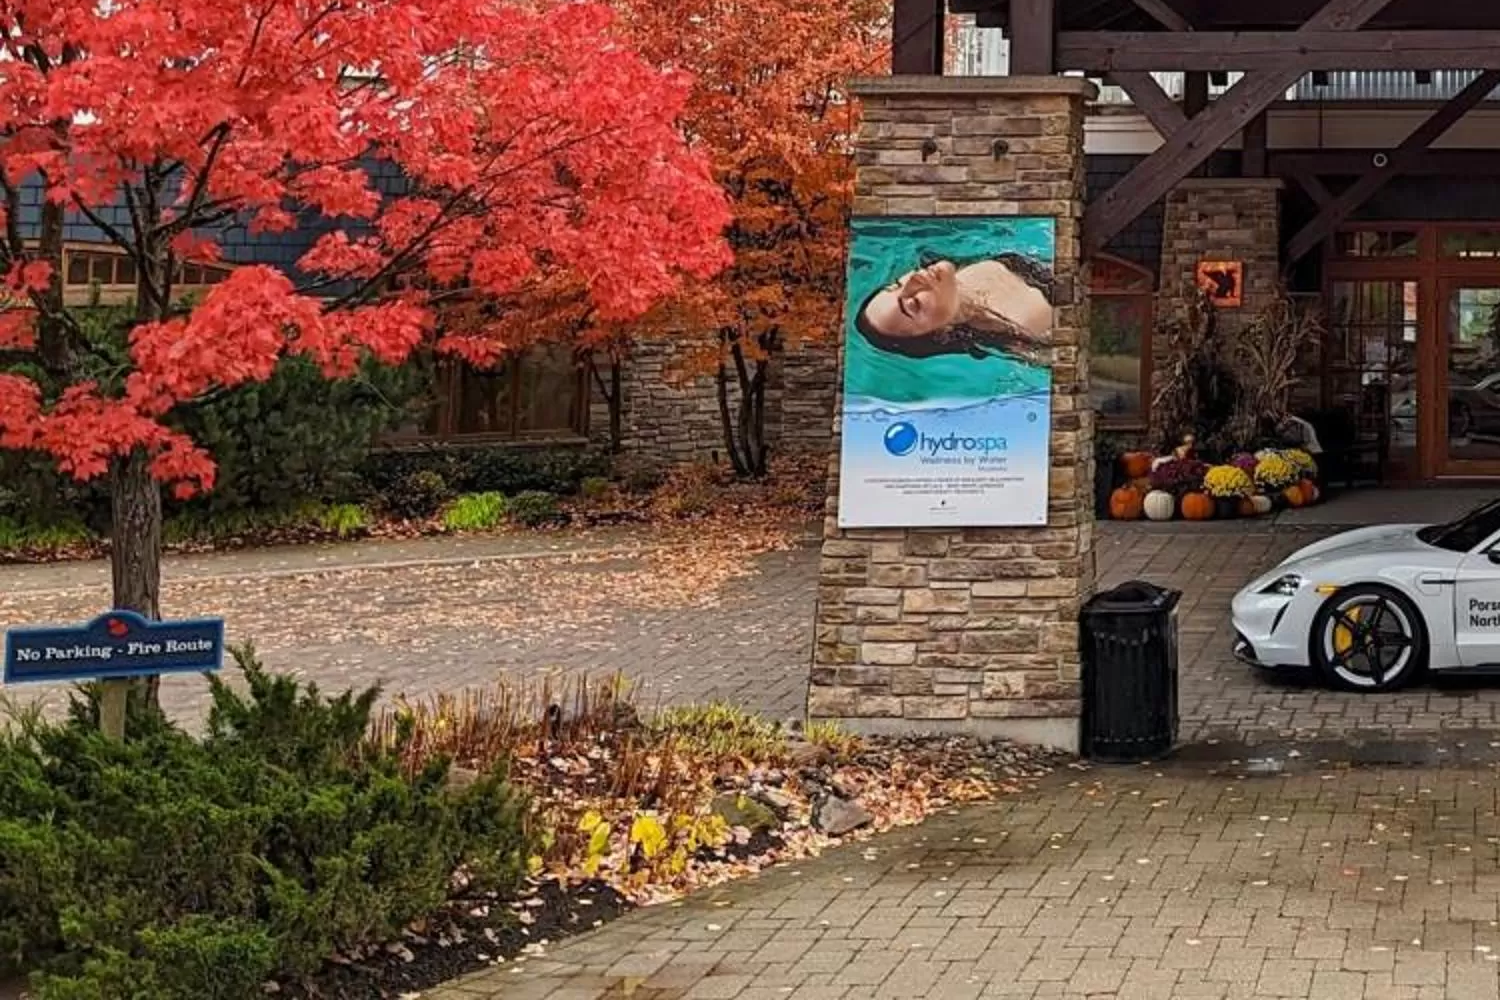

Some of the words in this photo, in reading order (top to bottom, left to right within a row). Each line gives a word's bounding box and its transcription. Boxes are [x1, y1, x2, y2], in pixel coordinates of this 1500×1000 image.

[920, 431, 1007, 456] hydrospa
[16, 648, 41, 661] No
[45, 645, 113, 660] Parking
[127, 642, 161, 656] Fire
[165, 638, 213, 653] Route
